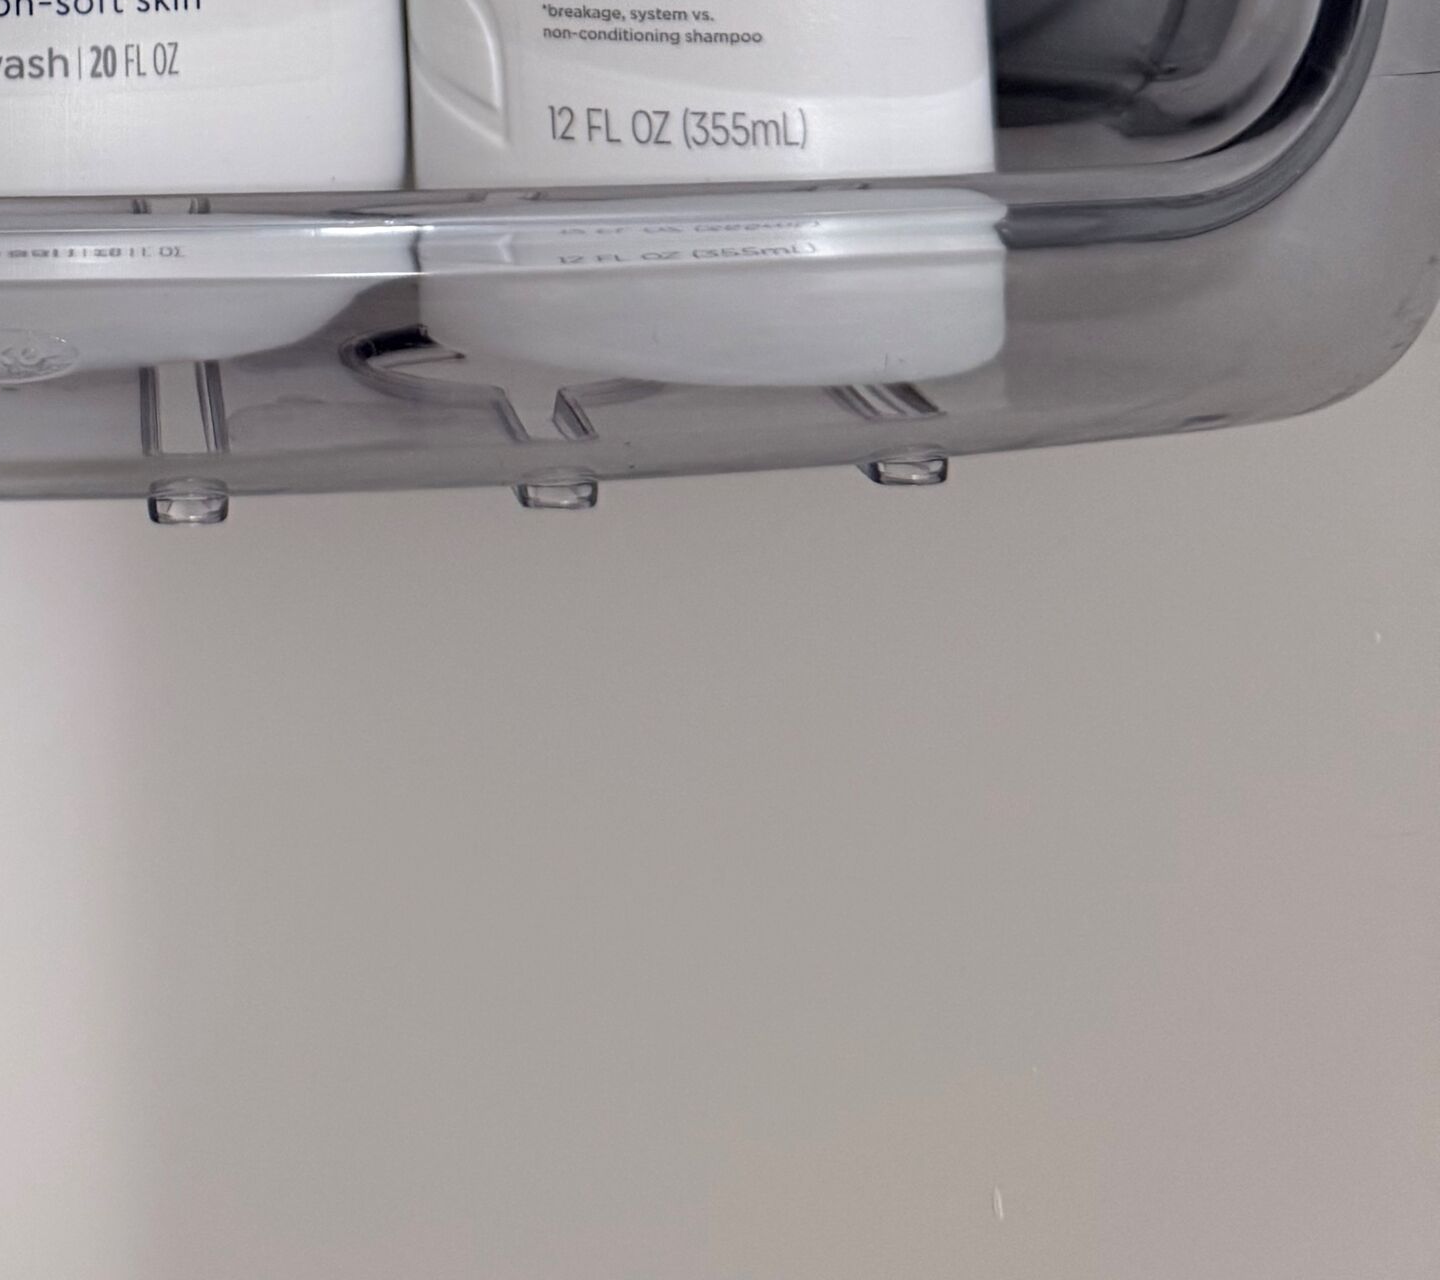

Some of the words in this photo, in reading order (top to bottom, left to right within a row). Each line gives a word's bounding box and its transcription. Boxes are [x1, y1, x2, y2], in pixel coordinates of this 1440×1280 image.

[630, 7, 688, 24] system
[692, 10, 714, 22] vs.
[542, 26, 681, 46] non-conditioning
[685, 29, 763, 46] shampoo
[90, 45, 117, 80] 20
[124, 44, 147, 77] FL
[152, 42, 180, 76] OZ
[548, 105, 575, 140] 12
[586, 107, 621, 142] FL
[631, 109, 672, 145] OZ
[682, 107, 808, 149] (355mL)
